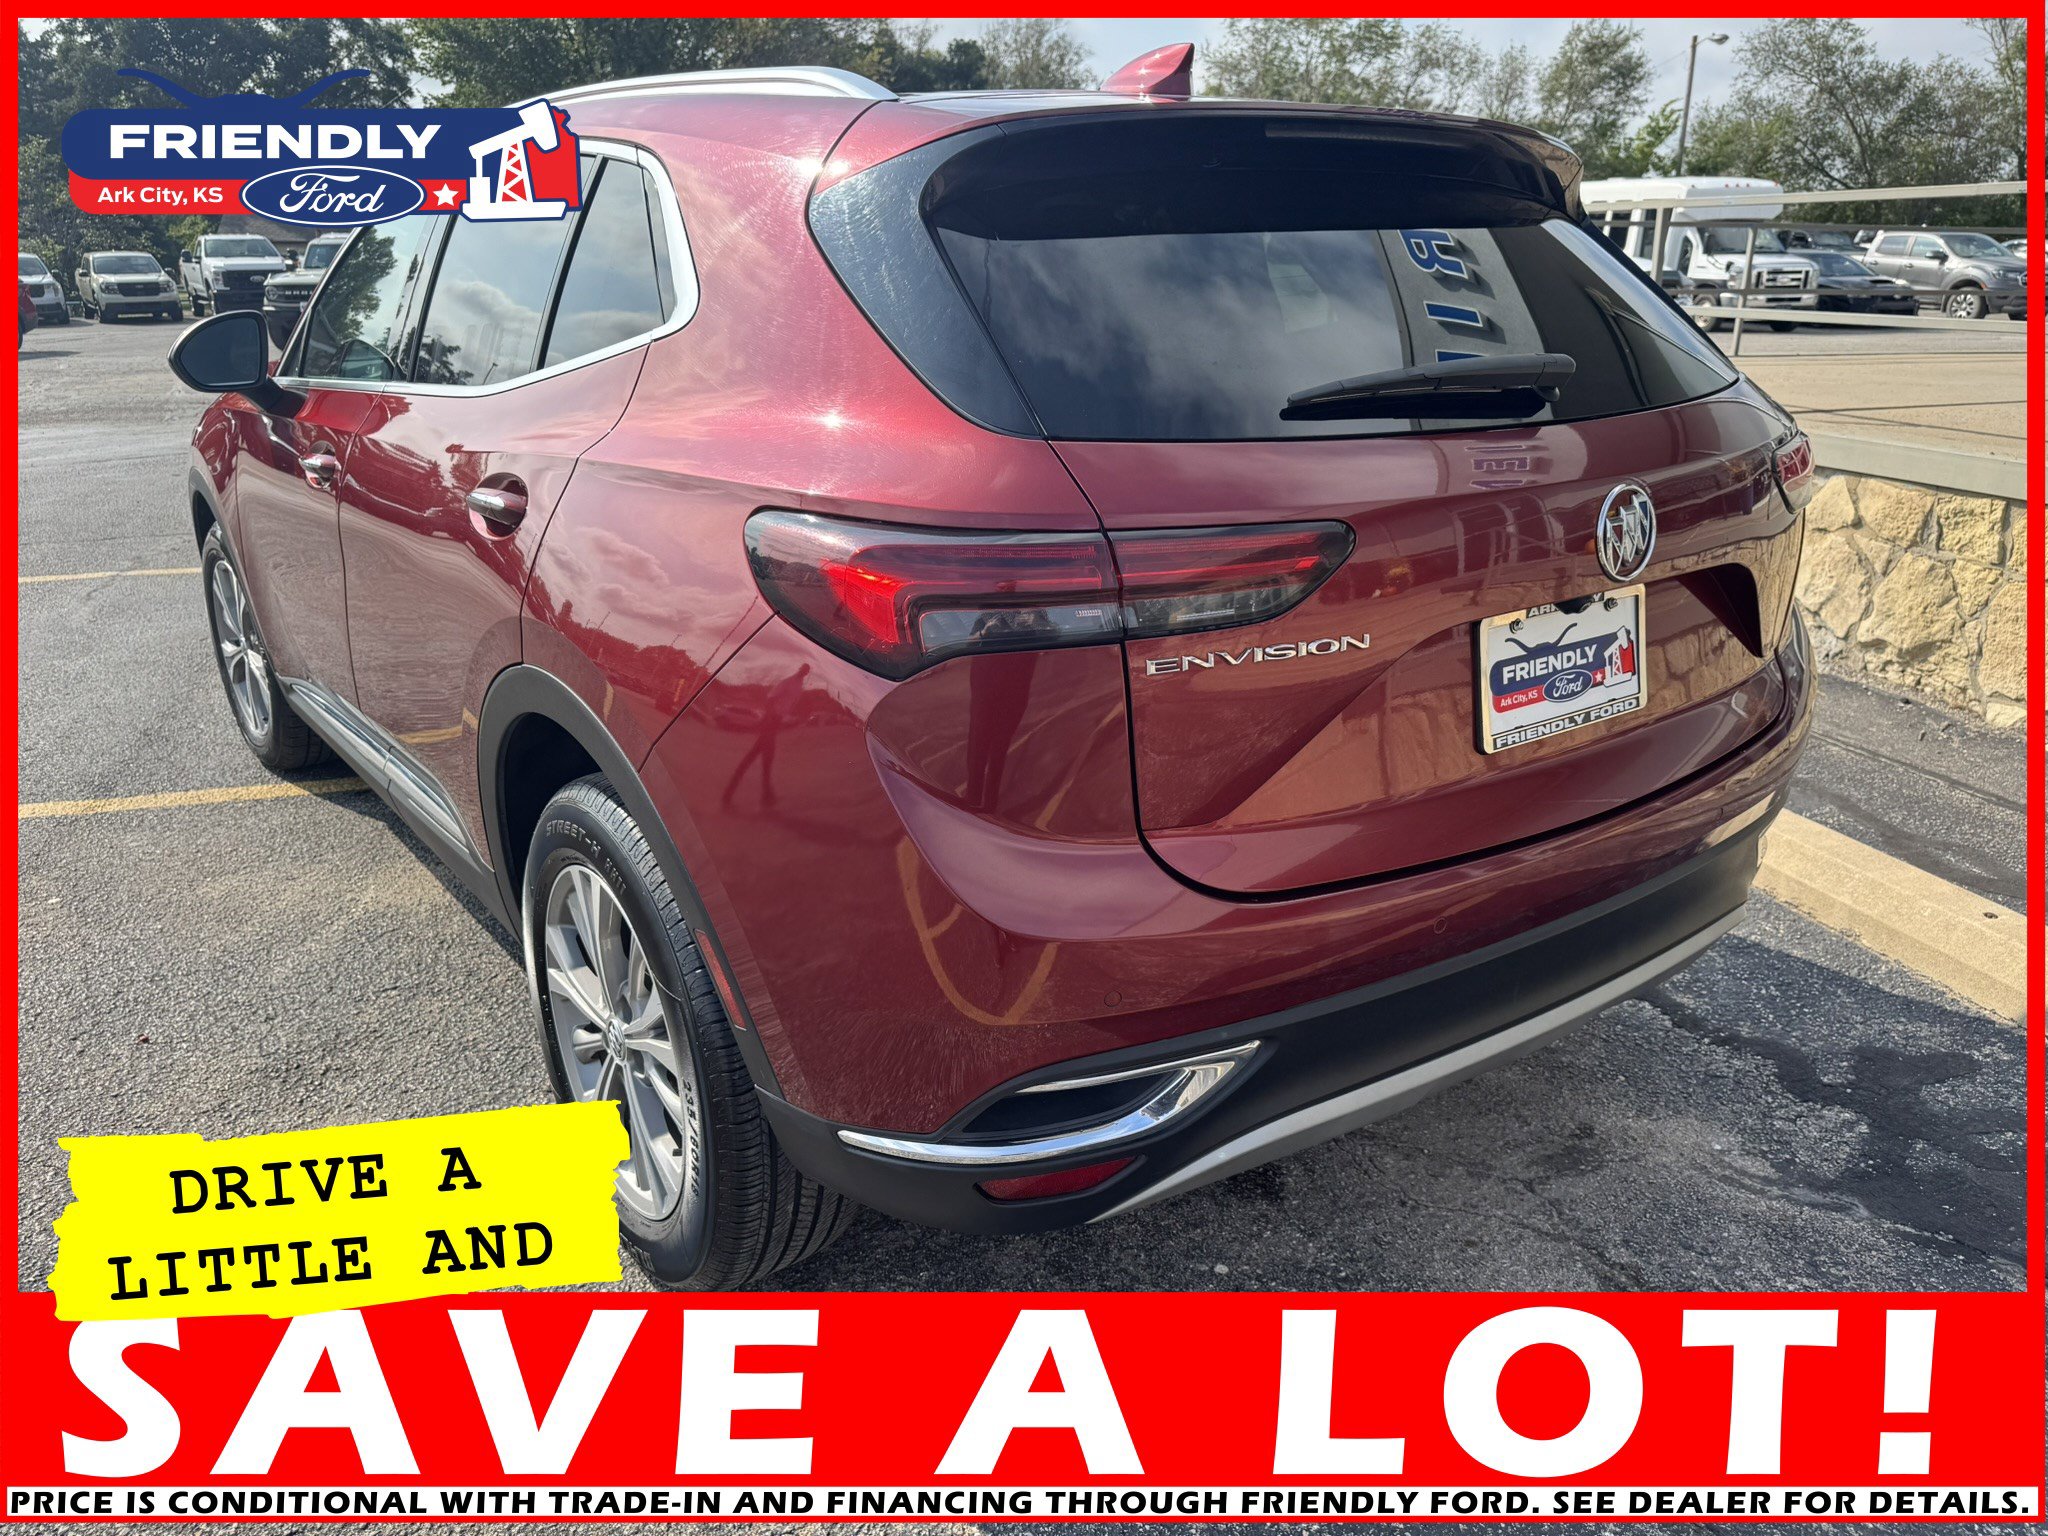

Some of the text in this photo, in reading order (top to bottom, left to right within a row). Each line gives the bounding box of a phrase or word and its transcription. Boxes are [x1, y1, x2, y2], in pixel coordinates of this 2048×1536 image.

[1146, 633, 1371, 676] ENVISION
[1502, 644, 1597, 685] FRIENDLY
[1500, 690, 1538, 707] Ark City, KS
[1552, 674, 1583, 698] Ford
[1496, 699, 1637, 749] FRIENDLY FORD
